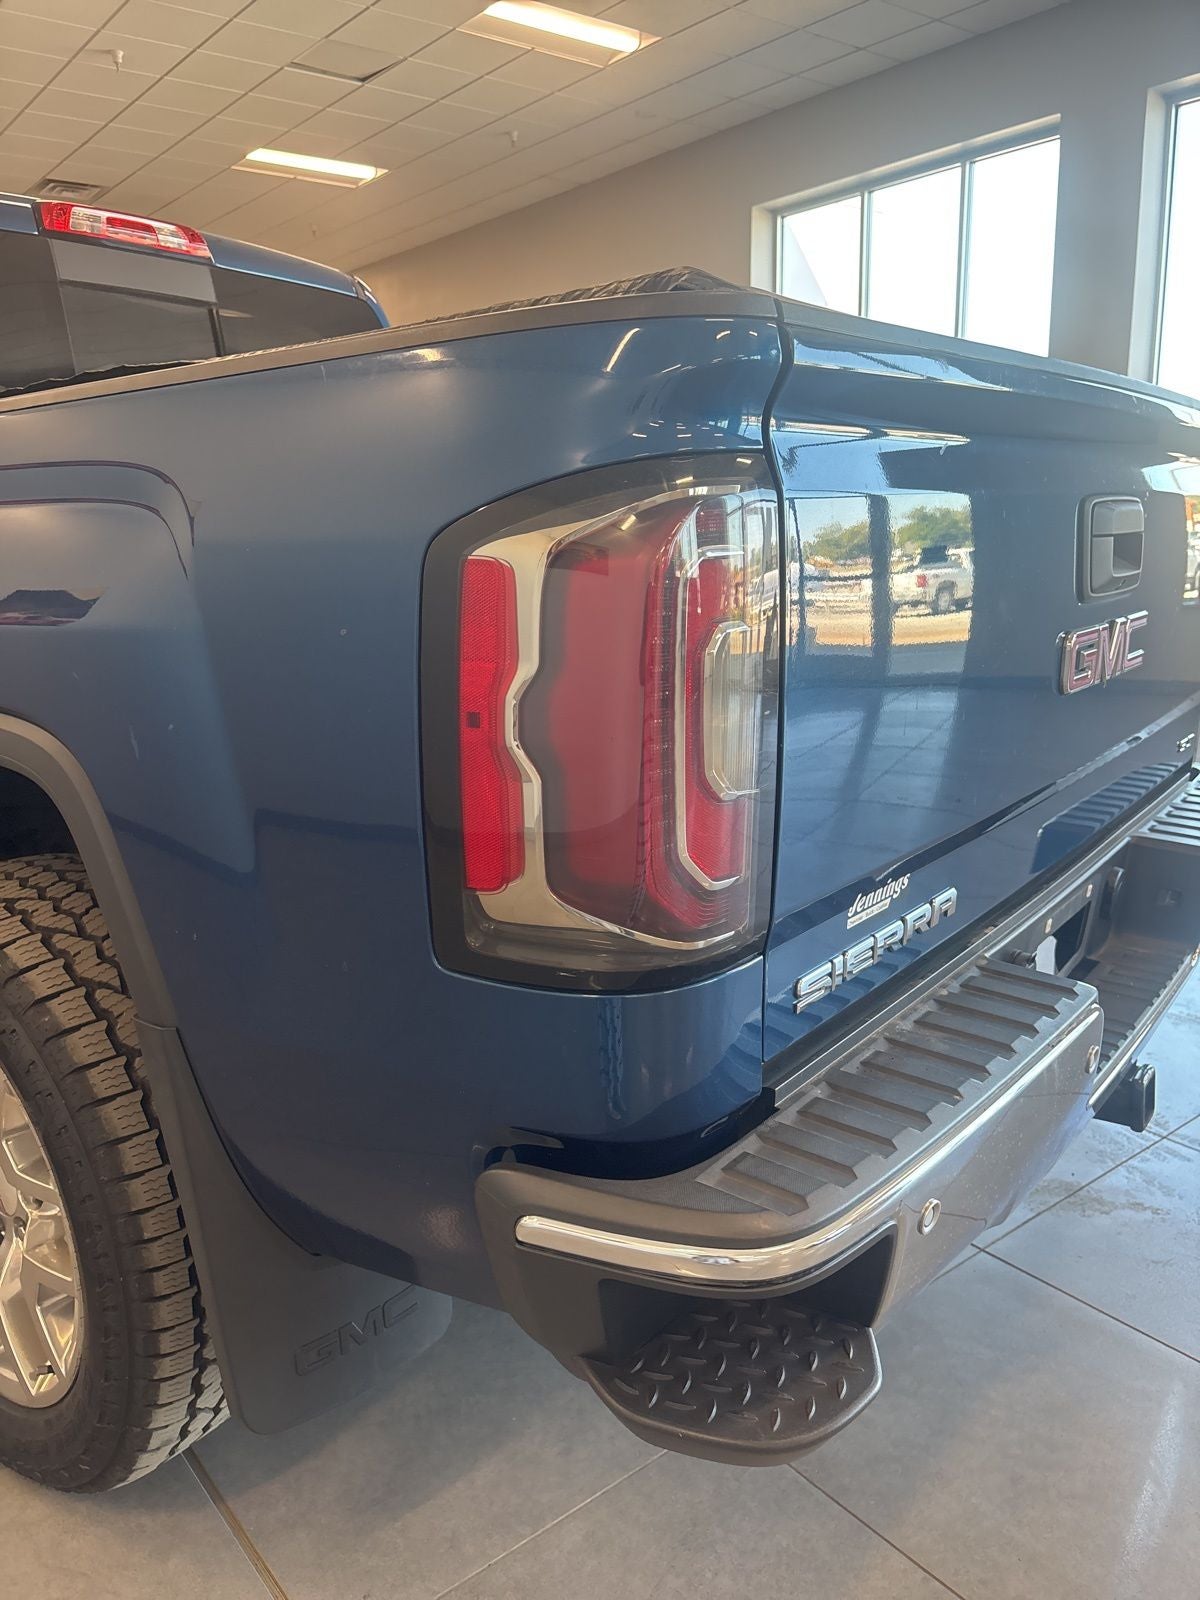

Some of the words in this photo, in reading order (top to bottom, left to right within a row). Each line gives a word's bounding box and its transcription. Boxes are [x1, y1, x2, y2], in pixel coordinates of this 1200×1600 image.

[1059, 610, 1149, 695] GMC
[847, 873, 911, 917] Jennings
[793, 887, 958, 1014] SIERRA
[294, 1284, 418, 1377] GMC
